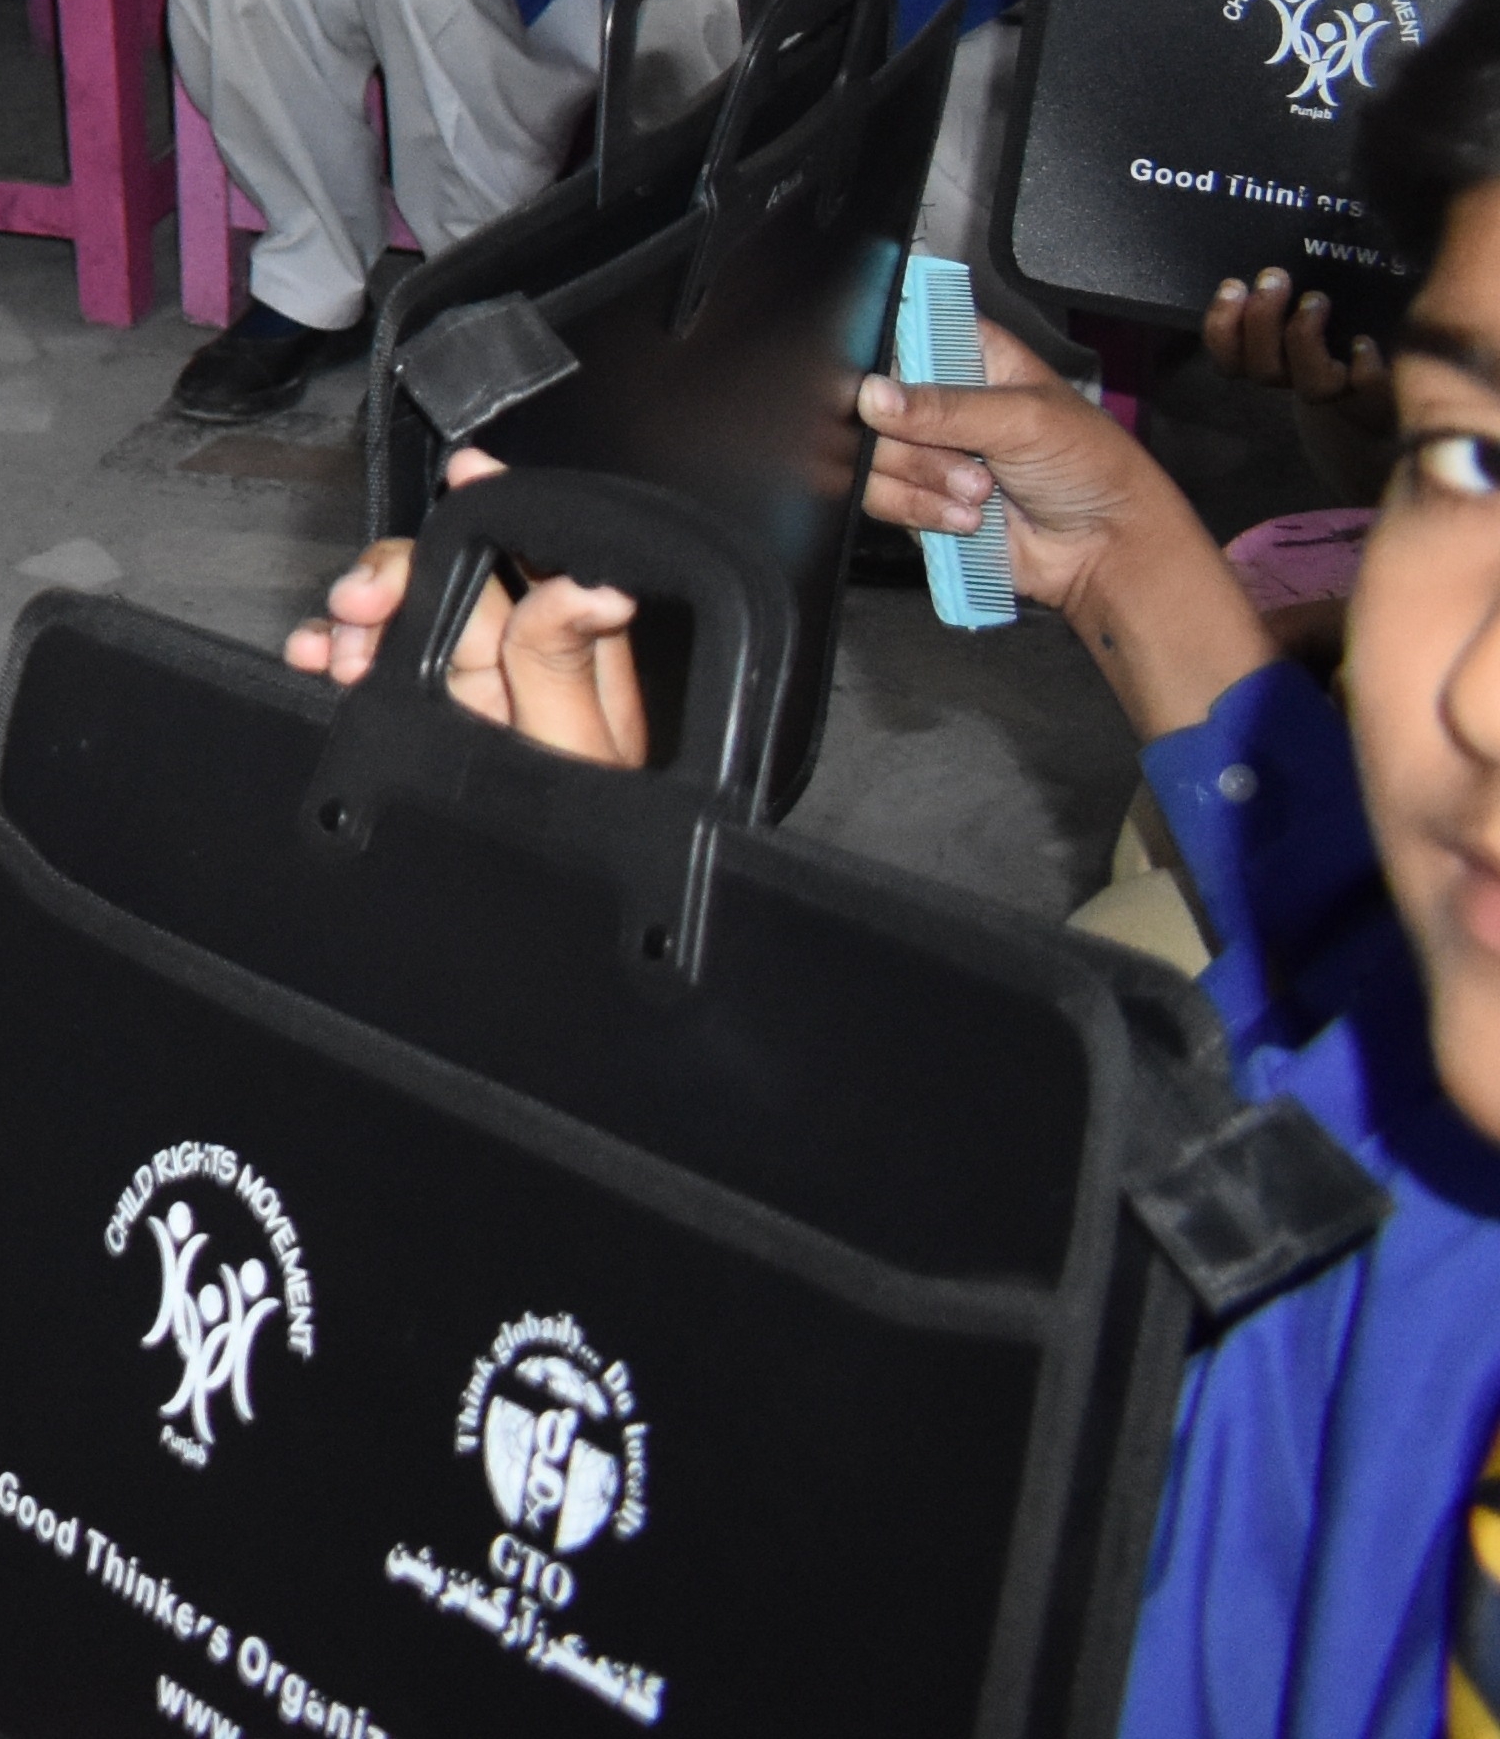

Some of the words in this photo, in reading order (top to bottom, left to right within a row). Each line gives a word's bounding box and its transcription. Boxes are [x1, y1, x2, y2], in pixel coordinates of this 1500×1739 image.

[1289, 104, 1334, 121] Punjab
[1129, 157, 1216, 193] Good
[103, 1163, 155, 1257] CHILD
[150, 1139, 238, 1187] RIGHTS
[234, 1162, 316, 1362] MOVEMENT
[453, 1355, 497, 1456] Think
[602, 1359, 636, 1420] Do
[159, 1424, 208, 1468] Punjab
[613, 1421, 651, 1541] locally
[83, 1527, 235, 1666] Thinkers
[488, 1532, 578, 1612] GTO
